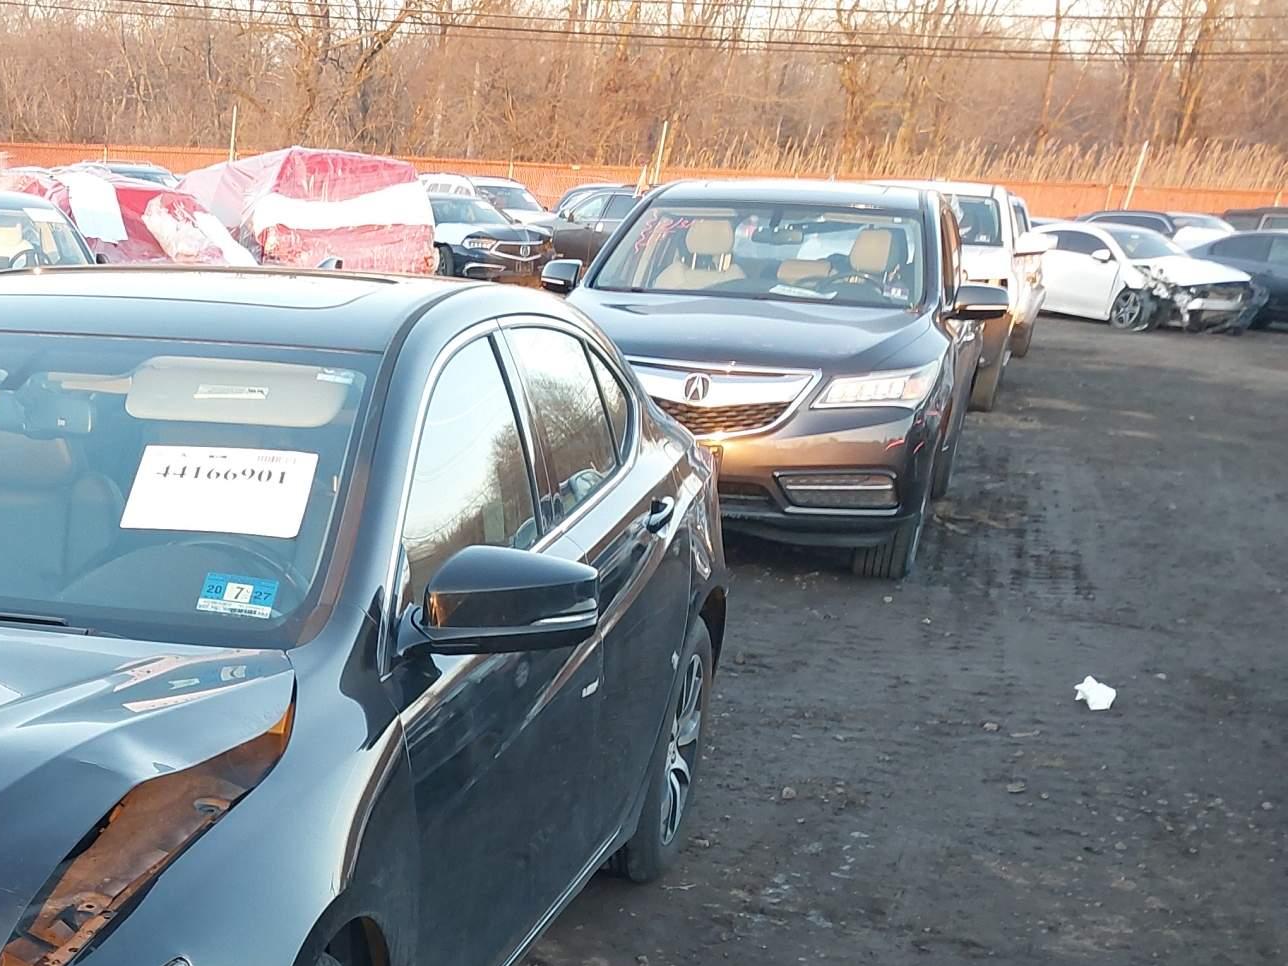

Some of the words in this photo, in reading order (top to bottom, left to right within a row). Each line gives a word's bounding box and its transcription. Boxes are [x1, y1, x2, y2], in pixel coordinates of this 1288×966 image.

[156, 465, 286, 484] 44166901
[206, 584, 223, 594] 20
[233, 586, 245, 600] 7
[253, 590, 272, 601] 27
